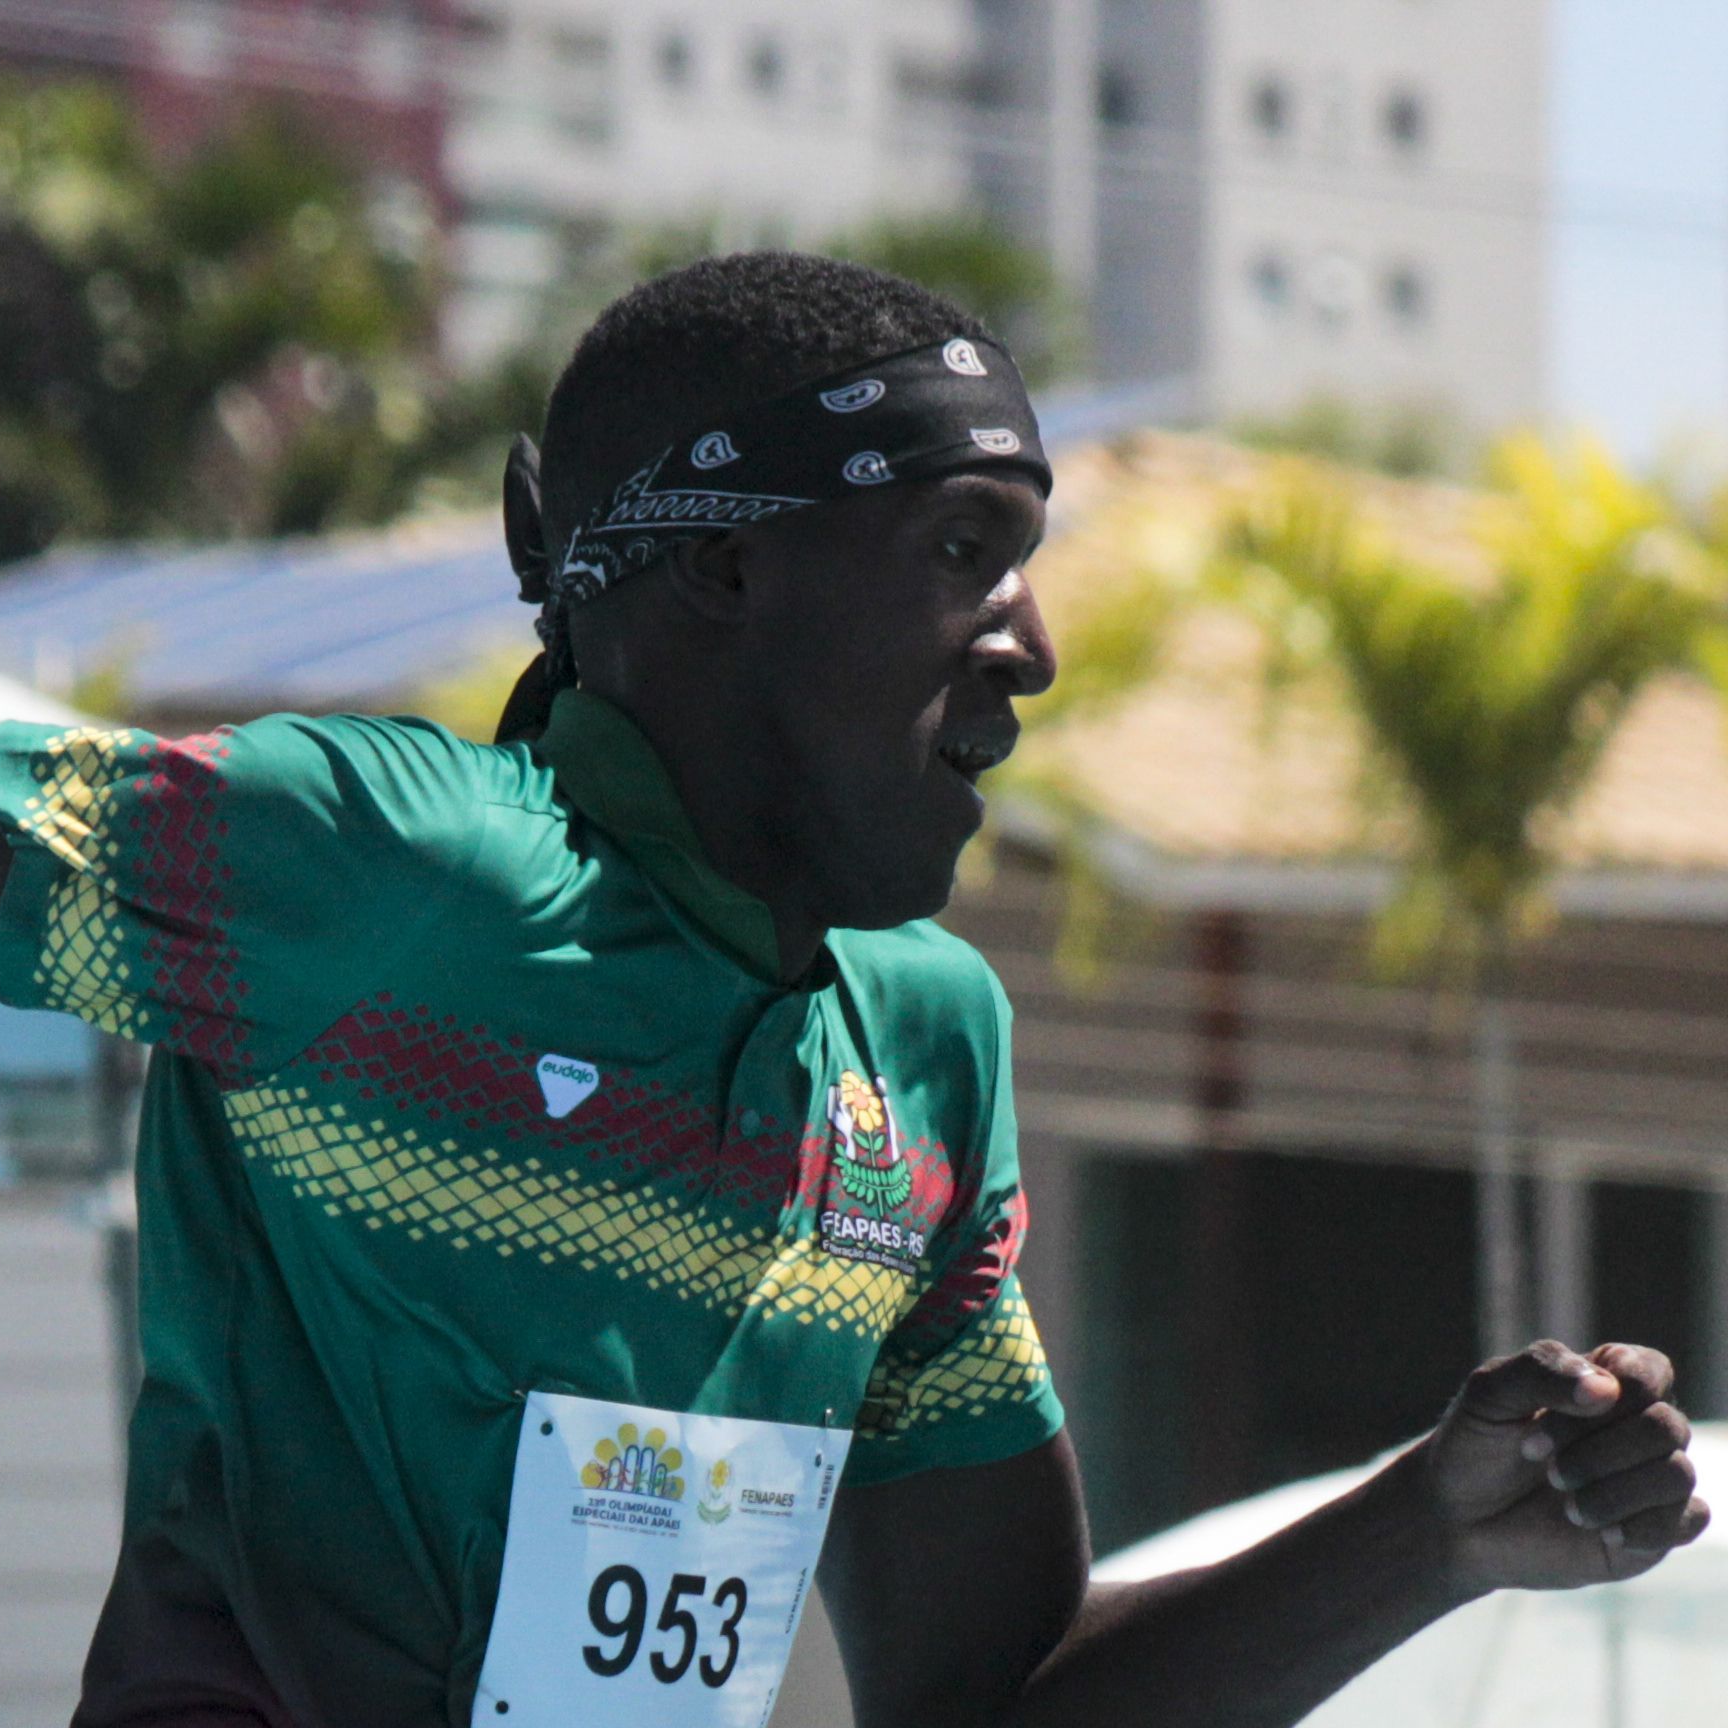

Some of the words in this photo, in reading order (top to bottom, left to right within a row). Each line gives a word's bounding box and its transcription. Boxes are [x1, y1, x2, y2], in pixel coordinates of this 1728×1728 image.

[609, 1500, 672, 1517] OLIMPÍADAS
[741, 1489, 794, 1507] FENAPAES
[573, 1506, 626, 1522] ESPECIAIS
[629, 1514, 648, 1525] DAS
[651, 1517, 681, 1530] APAES
[582, 1564, 748, 1688] 953
